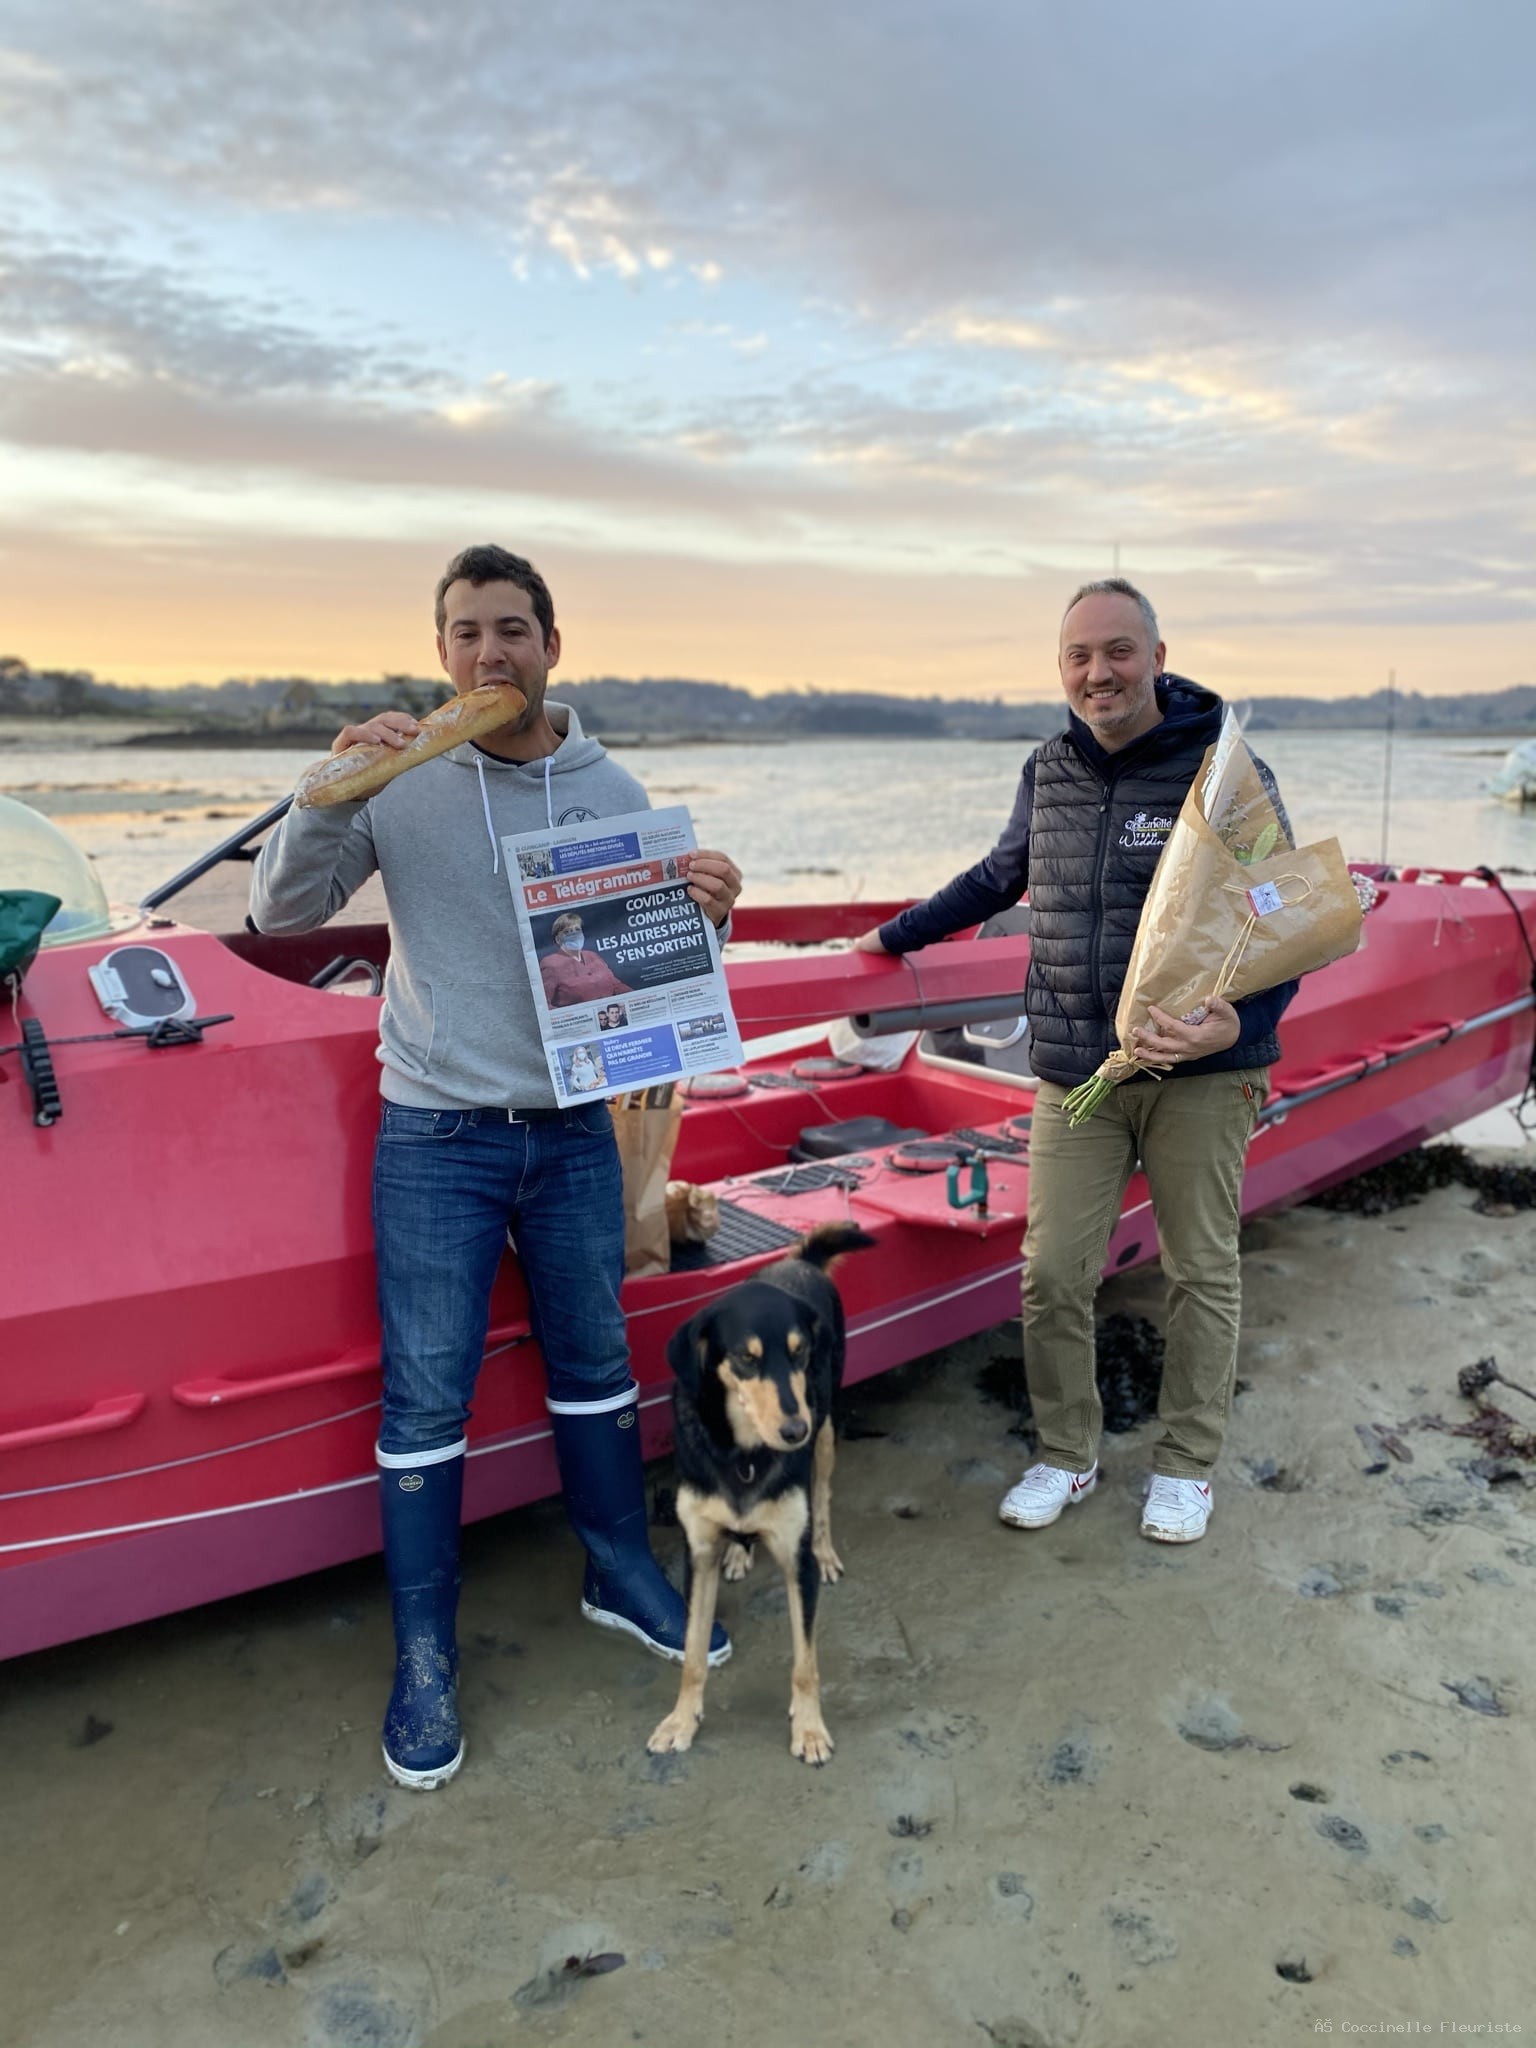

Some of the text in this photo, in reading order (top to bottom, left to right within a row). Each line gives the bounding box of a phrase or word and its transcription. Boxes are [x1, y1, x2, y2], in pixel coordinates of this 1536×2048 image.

[1118, 831, 1167, 847] Weddin
[528, 889, 547, 904] Le
[553, 869, 651, 898] Télégramme
[626, 889, 685, 912] COVID-19
[627, 902, 696, 927] COMMENT
[596, 918, 700, 951] LES AUTRES PAYS
[647, 933, 704, 957] SORTENT
